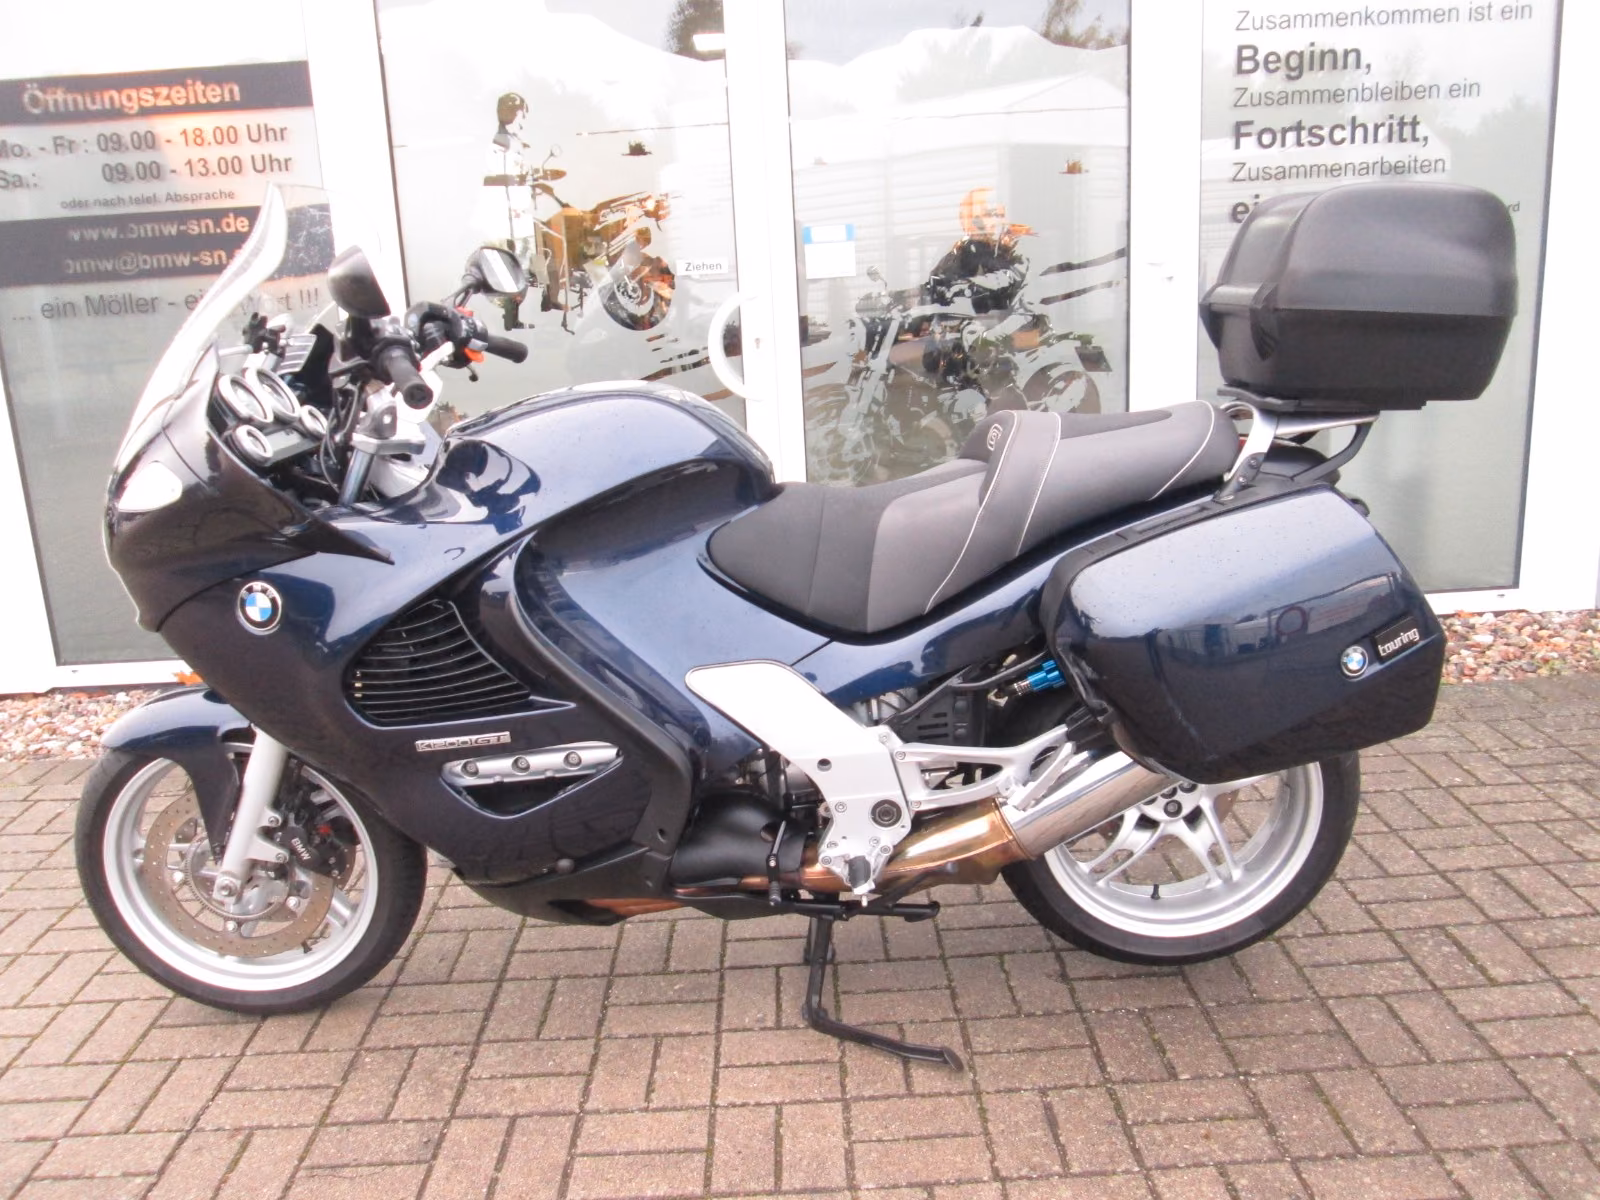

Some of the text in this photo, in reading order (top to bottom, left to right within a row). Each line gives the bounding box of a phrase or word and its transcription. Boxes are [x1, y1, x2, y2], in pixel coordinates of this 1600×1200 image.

[1235, 2, 1533, 31] Zusammenkommen ist ein
[1236, 42, 1372, 80] Beginn,
[23, 79, 241, 113] Öffnungszeiten
[1234, 80, 1481, 107] Zusammenbleiben ein
[97, 130, 157, 153] 09.00
[180, 125, 239, 147] 18.00
[247, 123, 288, 143] Uhr
[1234, 114, 1429, 149] Fortschritt,
[102, 160, 162, 184] 09.00
[185, 155, 243, 177] 13.00
[251, 153, 292, 173] Uhr
[1232, 156, 1446, 183] Zusammenarbeiten
[165, 189, 236, 205] Absprache
[64, 249, 241, 276] mw@bmw-sn.
[685, 261, 722, 272] Ziehen
[41, 299, 77, 320] ein
[86, 291, 158, 316] Möller
[1378, 628, 1420, 656] touring
[291, 837, 312, 860] BMW
